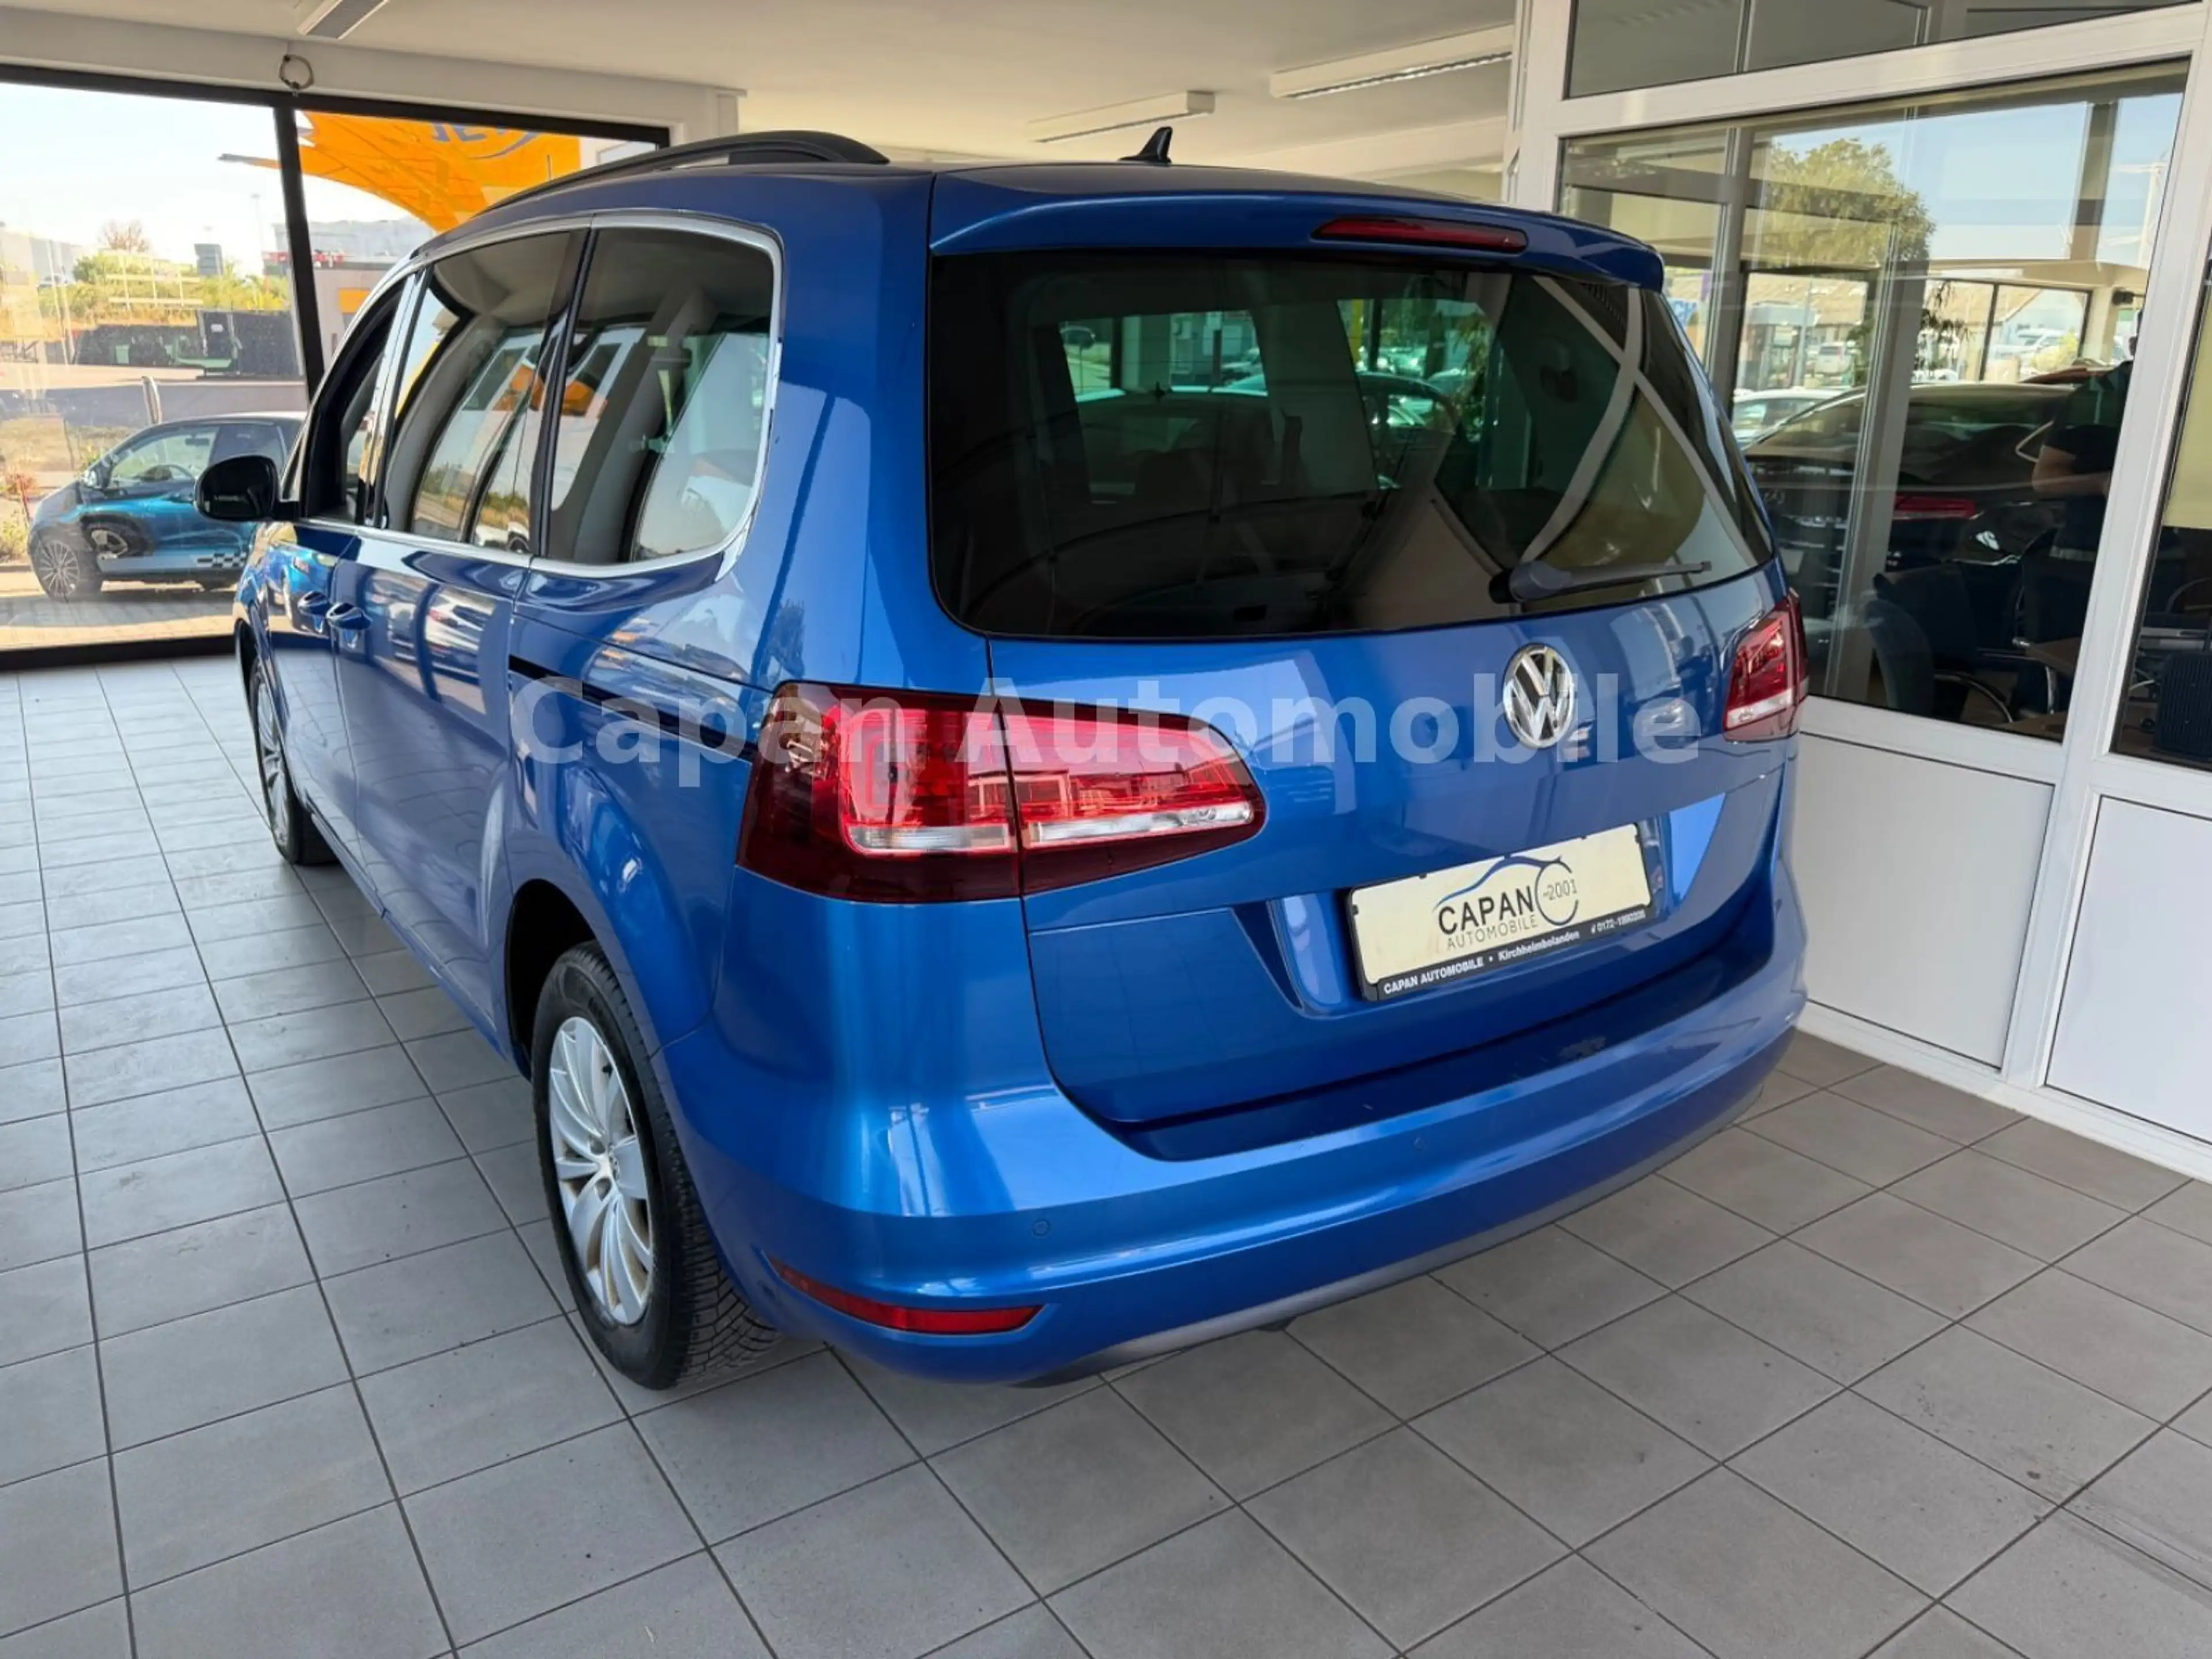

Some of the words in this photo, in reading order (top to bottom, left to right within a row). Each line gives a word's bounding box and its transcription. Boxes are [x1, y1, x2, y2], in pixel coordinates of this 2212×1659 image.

[1438, 885, 1534, 935] CAPAN
[1446, 914, 1539, 950] AUTOMOBILE
[1384, 975, 1418, 994] CAPAN
[1421, 956, 1484, 984] AUTOMOBILE
[1498, 931, 1580, 961] Kirchheimbolanden
